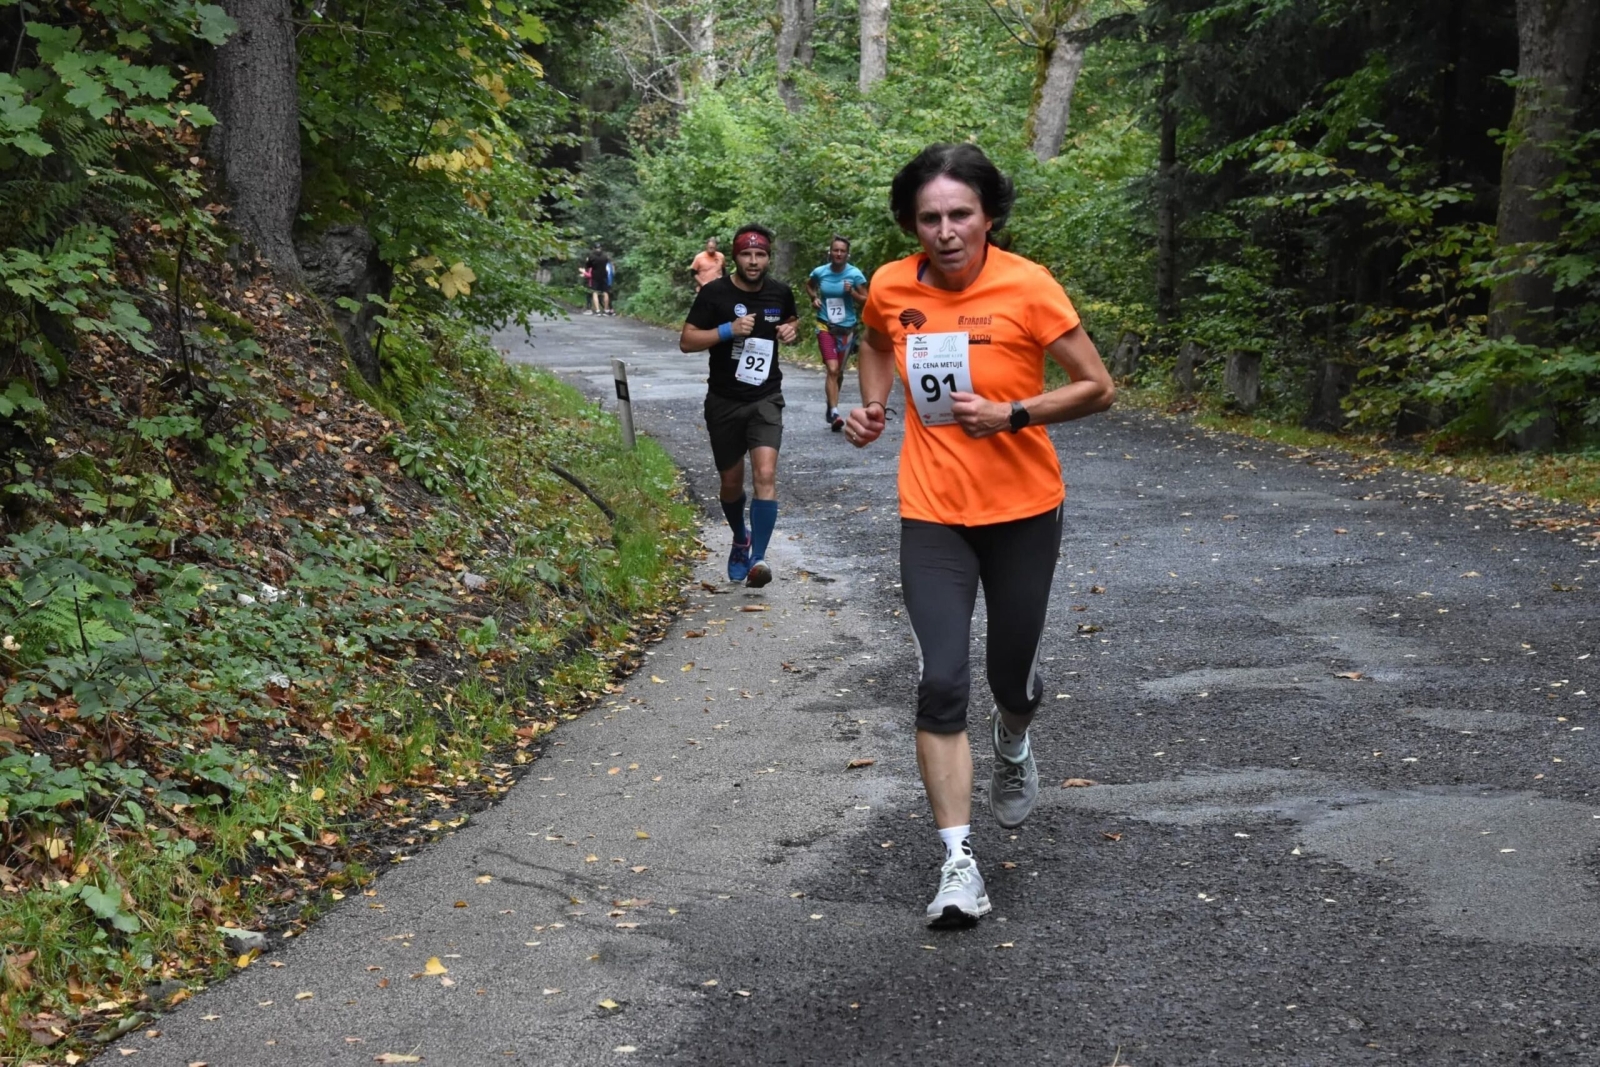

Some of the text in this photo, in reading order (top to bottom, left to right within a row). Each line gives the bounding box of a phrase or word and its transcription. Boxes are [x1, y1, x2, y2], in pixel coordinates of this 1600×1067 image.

[830, 307, 842, 316] 72
[745, 355, 765, 372] 92
[940, 361, 963, 369] METUJE
[920, 373, 957, 403] 91
